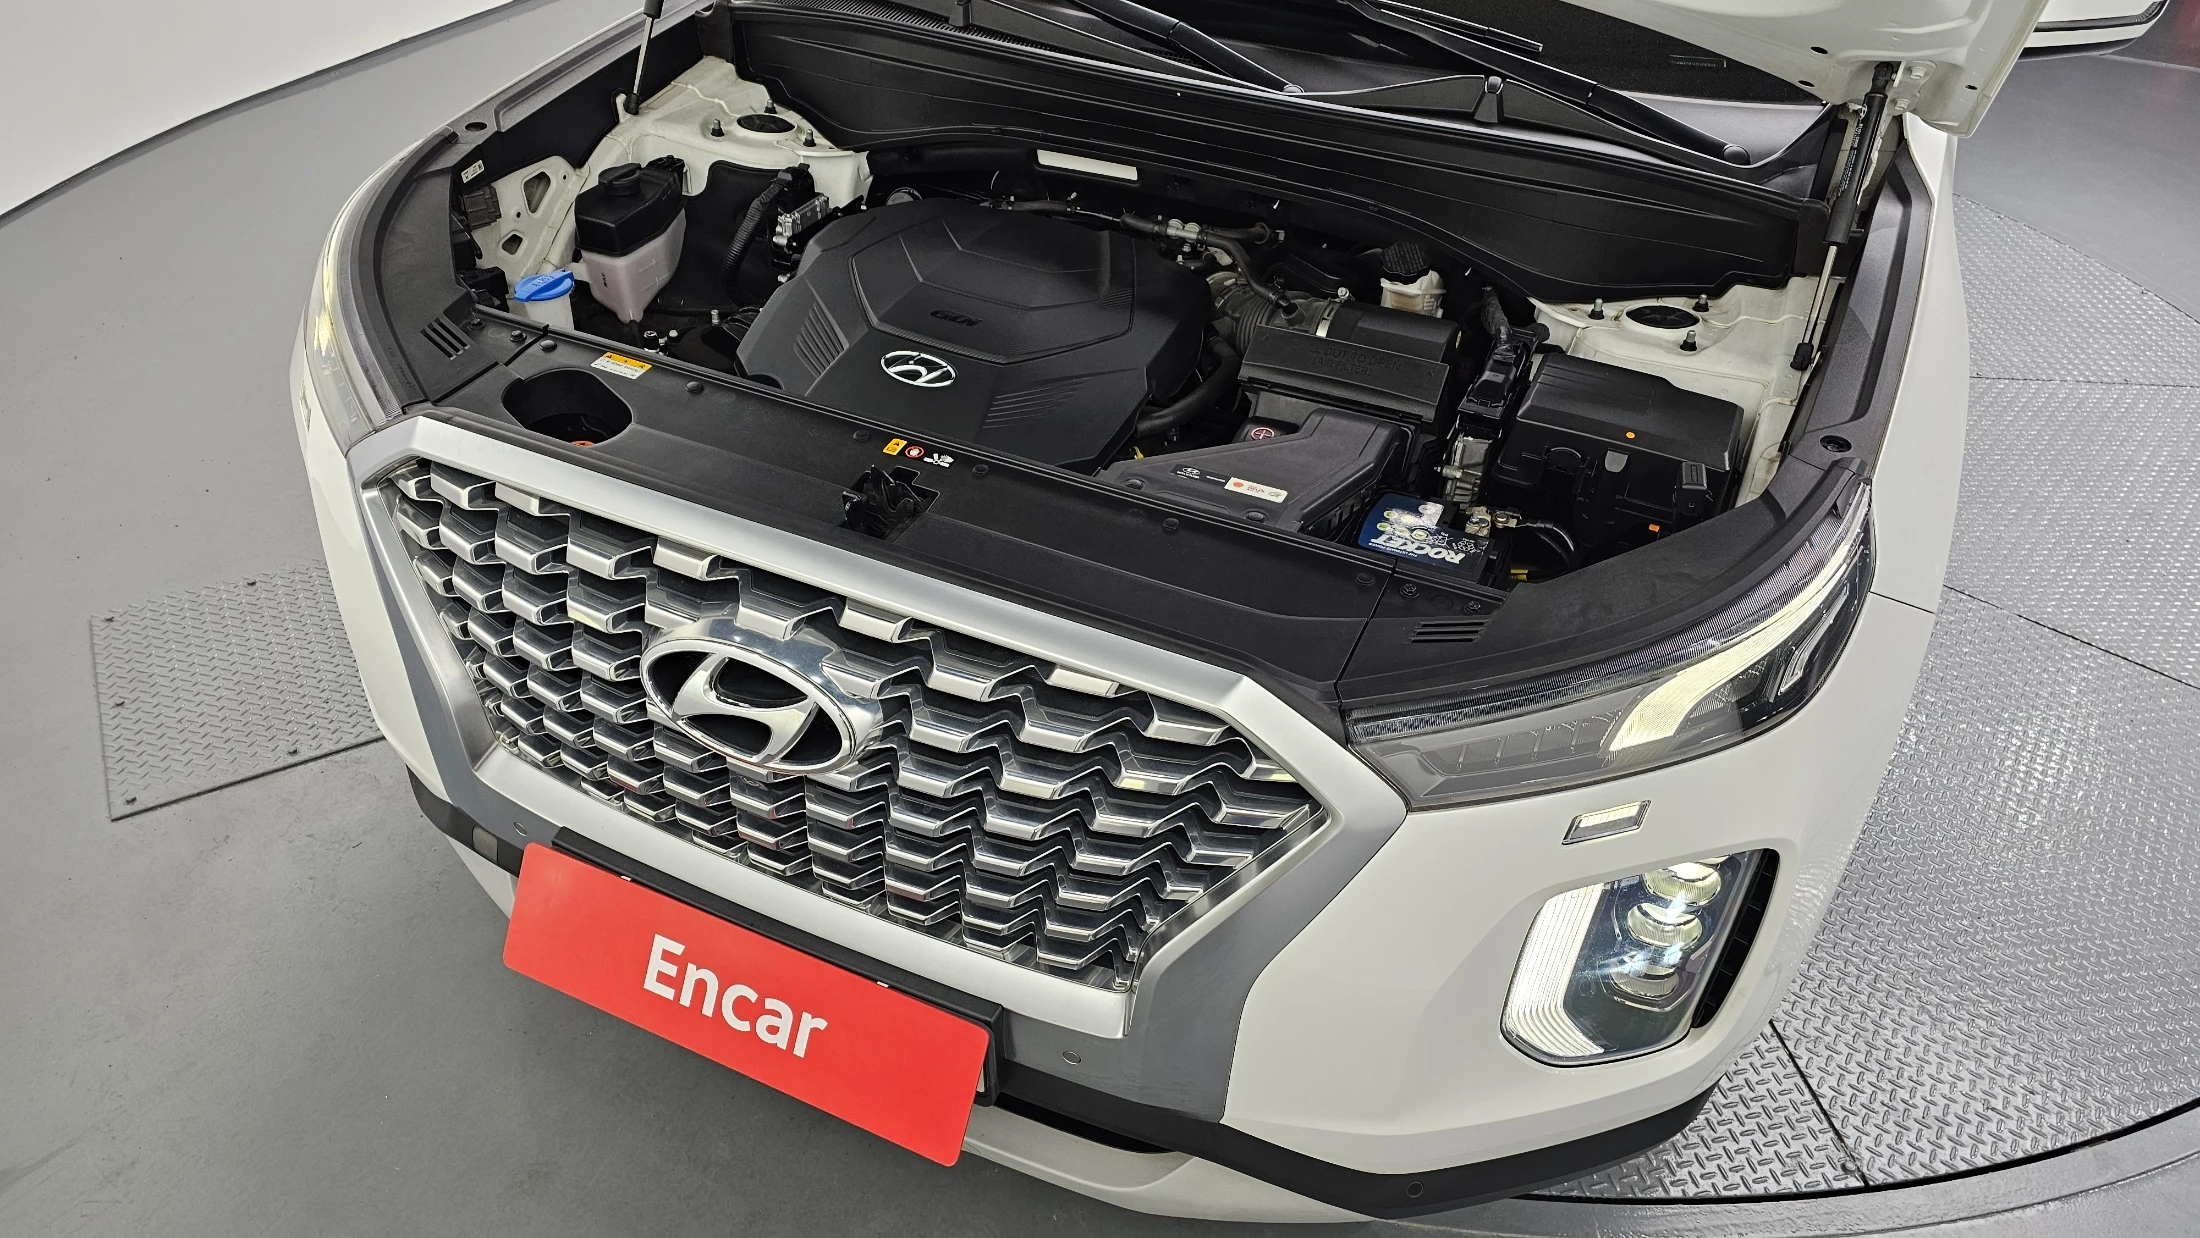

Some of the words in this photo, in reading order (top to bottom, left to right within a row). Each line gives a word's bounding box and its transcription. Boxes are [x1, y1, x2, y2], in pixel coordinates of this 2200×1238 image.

[1323, 346, 1348, 359] OUT
[1350, 350, 1367, 364] TO
[1371, 534, 1465, 564] ROCKET
[643, 933, 828, 1058] Encar
